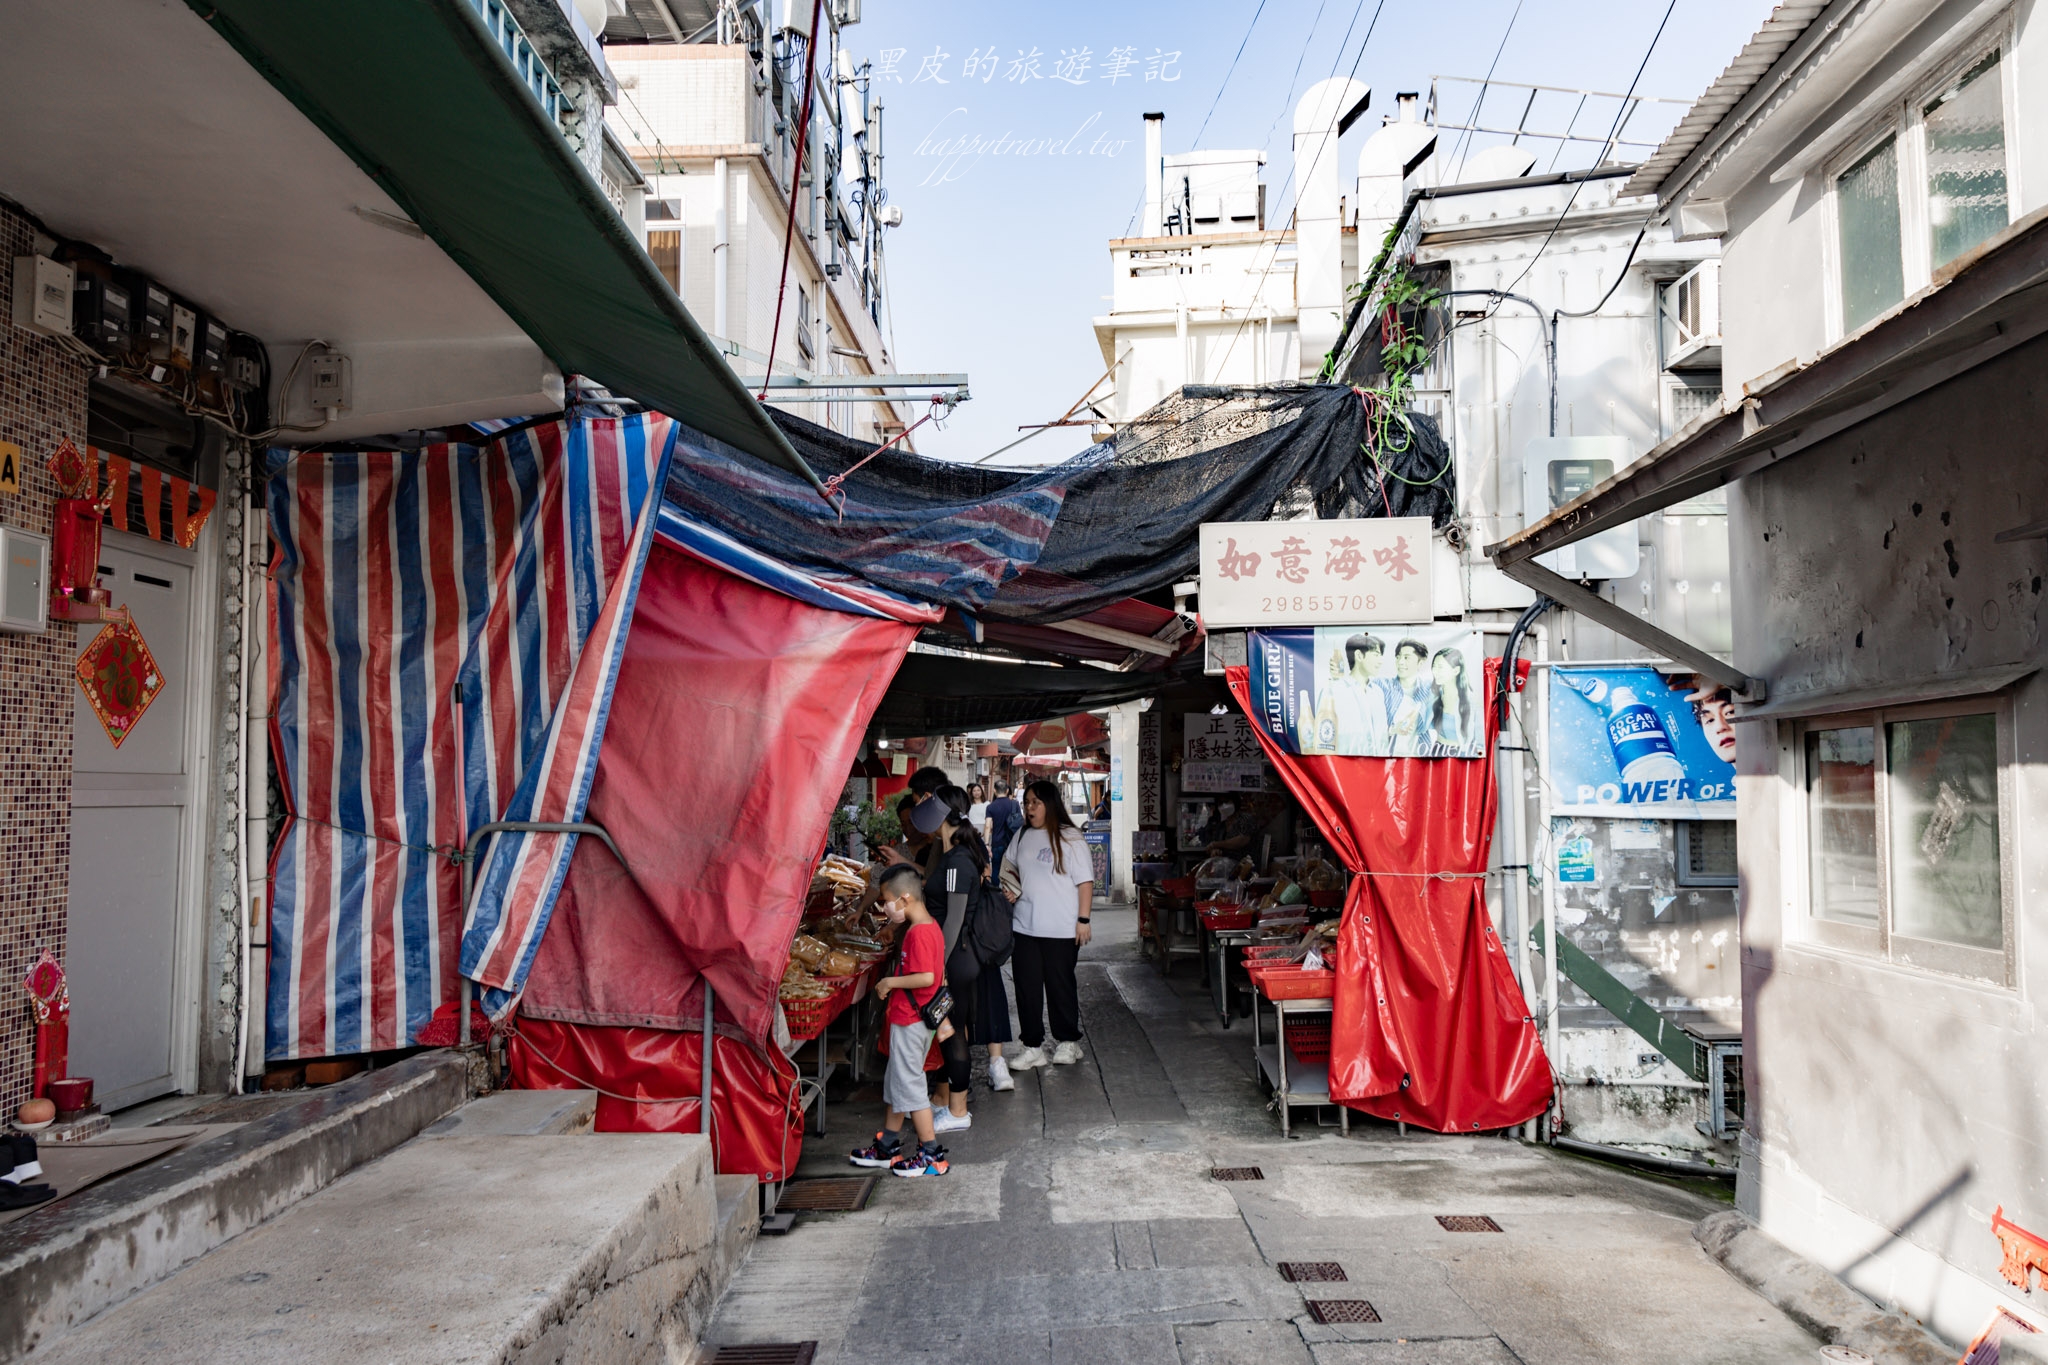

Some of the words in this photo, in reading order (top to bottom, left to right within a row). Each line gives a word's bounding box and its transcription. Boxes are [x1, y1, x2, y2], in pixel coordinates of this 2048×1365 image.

[1217, 535, 1419, 583] 如意海味
[1262, 594, 1377, 613] 29855708
[1268, 644, 1281, 688] GIRL
[1268, 690, 1284, 734] BLUE
[1206, 718, 1250, 736] 正宗
[1609, 713, 1657, 735] POCARI
[1612, 721, 1656, 744] SWEAT
[1700, 783, 1725, 800] OF
